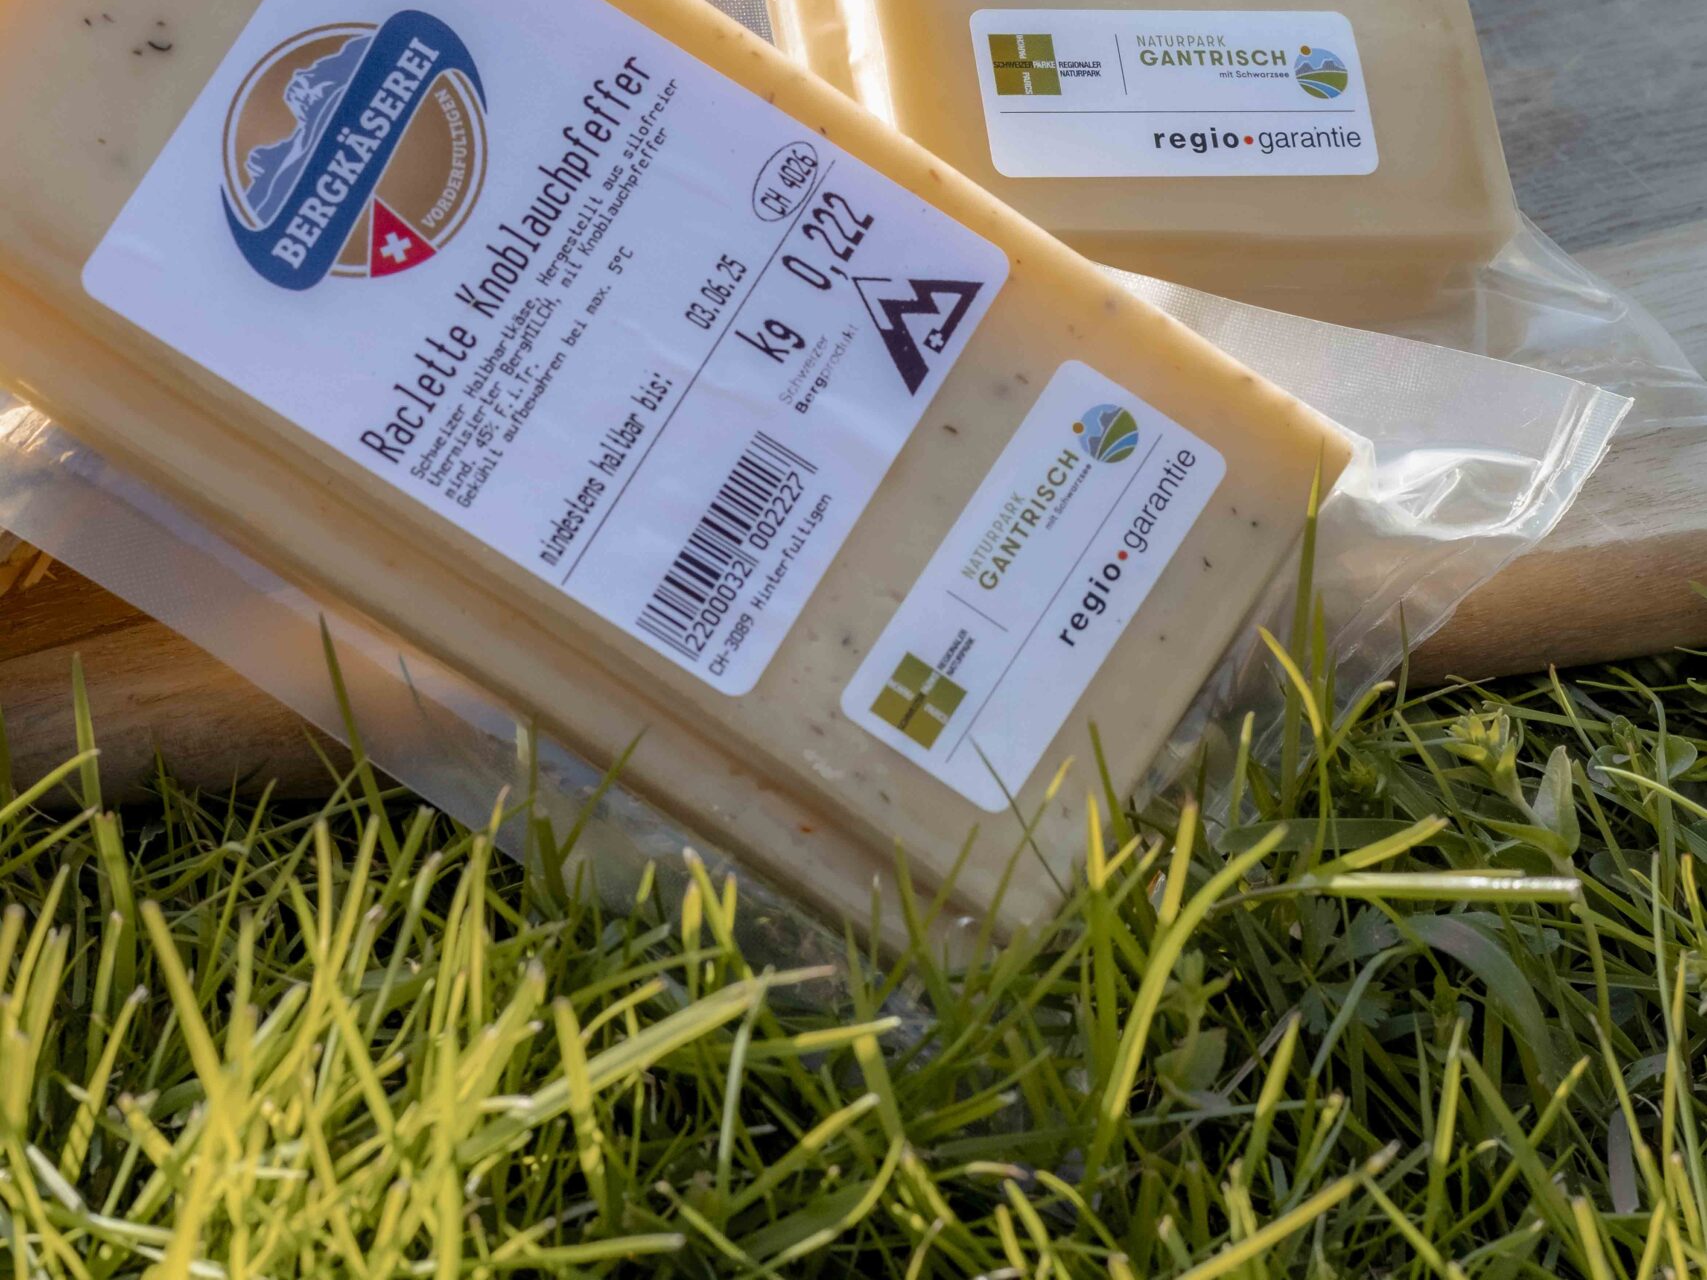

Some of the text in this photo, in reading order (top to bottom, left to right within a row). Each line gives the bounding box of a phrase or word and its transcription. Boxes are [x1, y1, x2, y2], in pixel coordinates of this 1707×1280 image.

[1058, 61, 1102, 69] REGIONALER
[1060, 70, 1101, 78] NATURPARK
[1136, 34, 1226, 47] NATURPARK
[1139, 49, 1287, 67] GANTRISCH
[1219, 70, 1289, 79] mit Schwarzsee
[271, 36, 440, 269] BERGKÄSEREI
[421, 88, 467, 229] VORDERFULTIGEN
[760, 149, 819, 216] CH 4026
[359, 56, 650, 464] Raclette Knoblauchpfeffer
[410, 78, 678, 480] Schweizer Halbhartkäse, Hergestellt aus silofreier
[427, 127, 667, 488] thermisierter BergMILCH, mit Knoblauchpfeffer
[685, 254, 748, 330] 03.06.25
[735, 192, 874, 363] kg 0,222
[456, 449, 503, 508] Gekühlt
[503, 350, 567, 443] aufbewahren
[561, 319, 587, 348] bei
[585, 285, 613, 316] max.
[778, 333, 829, 405] Schweizer
[445, 460, 476, 499] mind.
[476, 422, 499, 449] 45%
[539, 372, 674, 567] mindestens haltbar bis:
[978, 449, 1080, 591] GANTRISCH
[685, 471, 806, 652] 2200032 002227
[708, 493, 833, 677] CH-3089 Hinterfultigen
[961, 490, 1026, 580] NATURPARK
